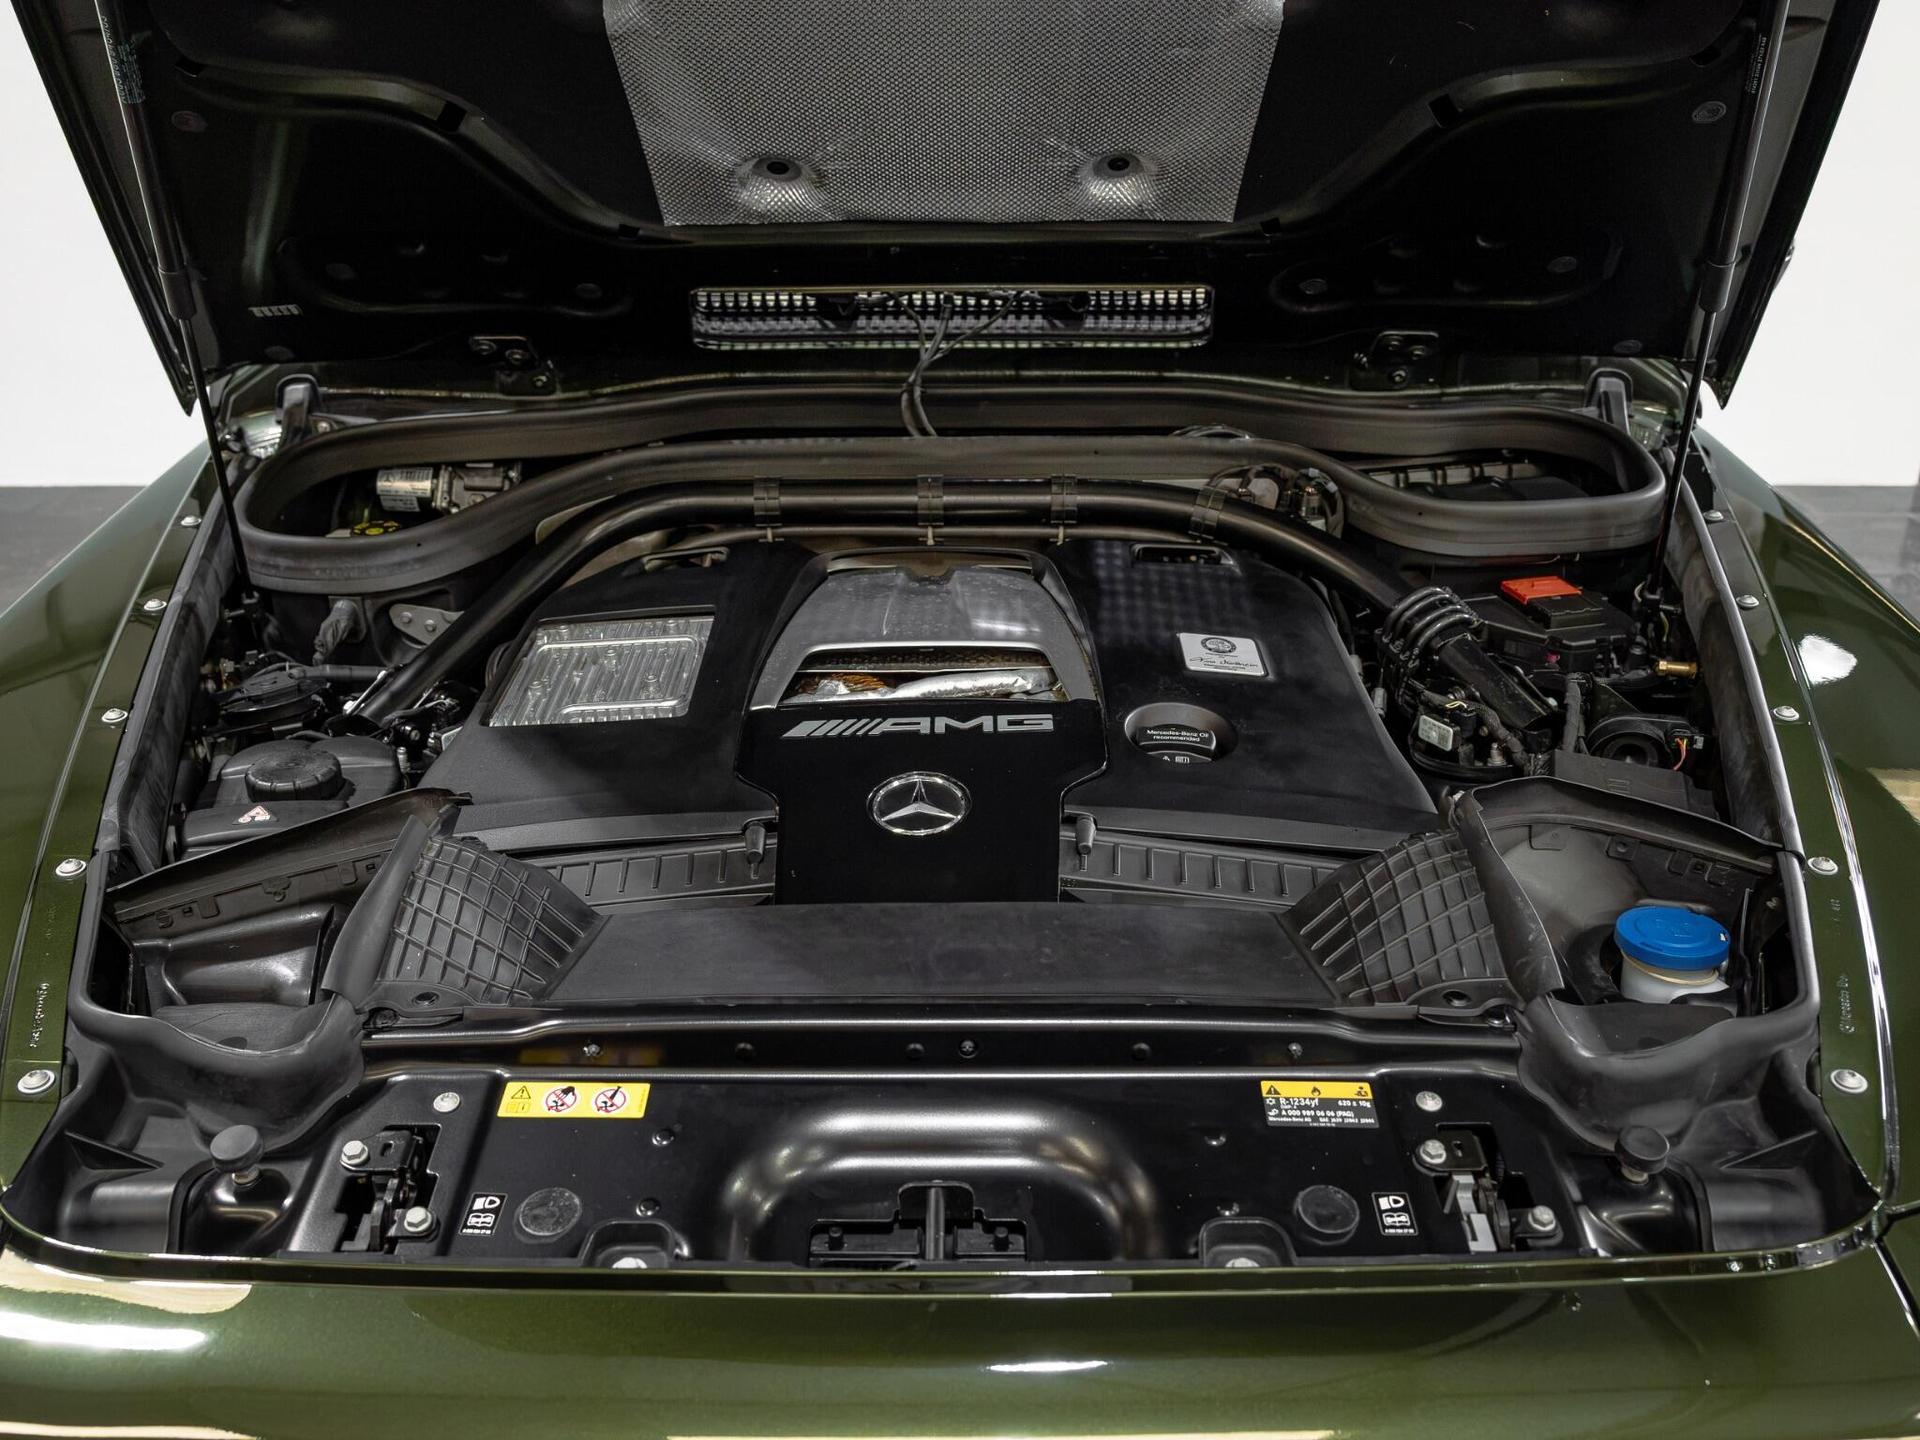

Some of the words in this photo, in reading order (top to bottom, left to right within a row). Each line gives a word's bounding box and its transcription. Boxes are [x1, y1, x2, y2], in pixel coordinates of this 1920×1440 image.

[865, 713, 1054, 736] AMG
[1146, 729, 1198, 737] Mercedes-Benz
[1280, 1098, 1319, 1108] R-1234yf
